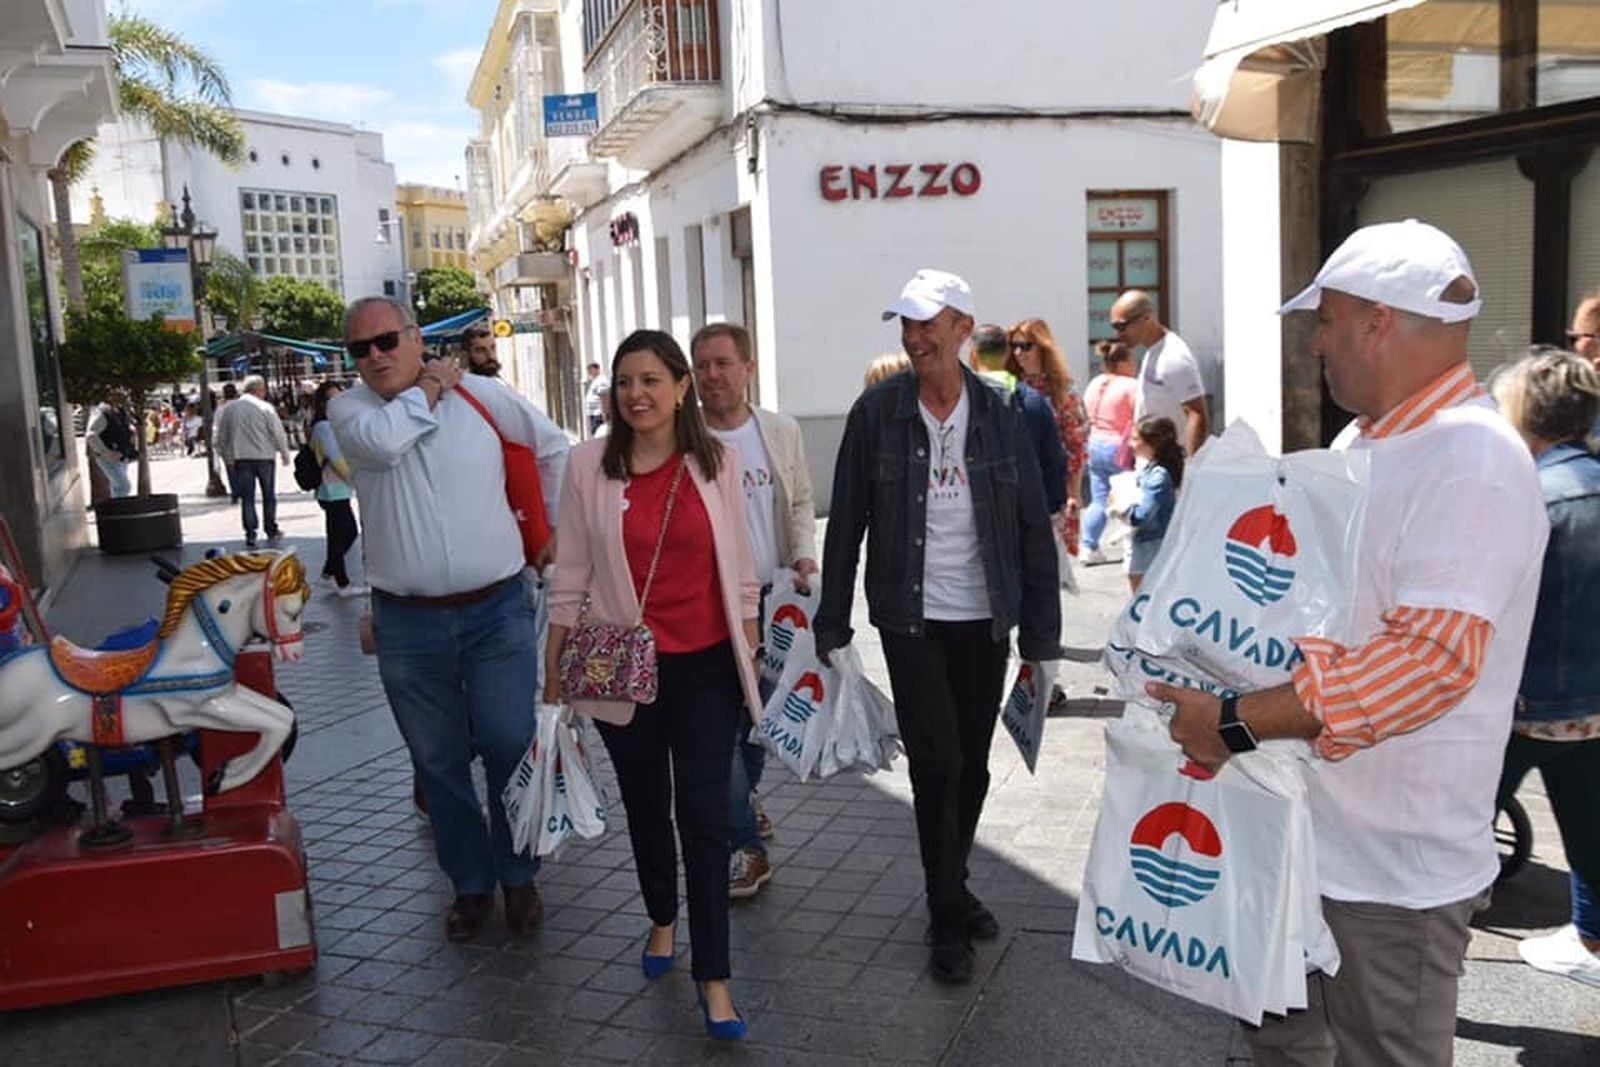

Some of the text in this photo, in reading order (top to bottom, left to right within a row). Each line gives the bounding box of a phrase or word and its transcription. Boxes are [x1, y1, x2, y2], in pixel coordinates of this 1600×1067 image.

[819, 161, 982, 202] ENZZO
[742, 467, 774, 489] AD
[927, 465, 966, 489] VA
[1170, 597, 1305, 672] CAVADA
[546, 813, 574, 833] CA
[1095, 906, 1230, 979] CAVADA
